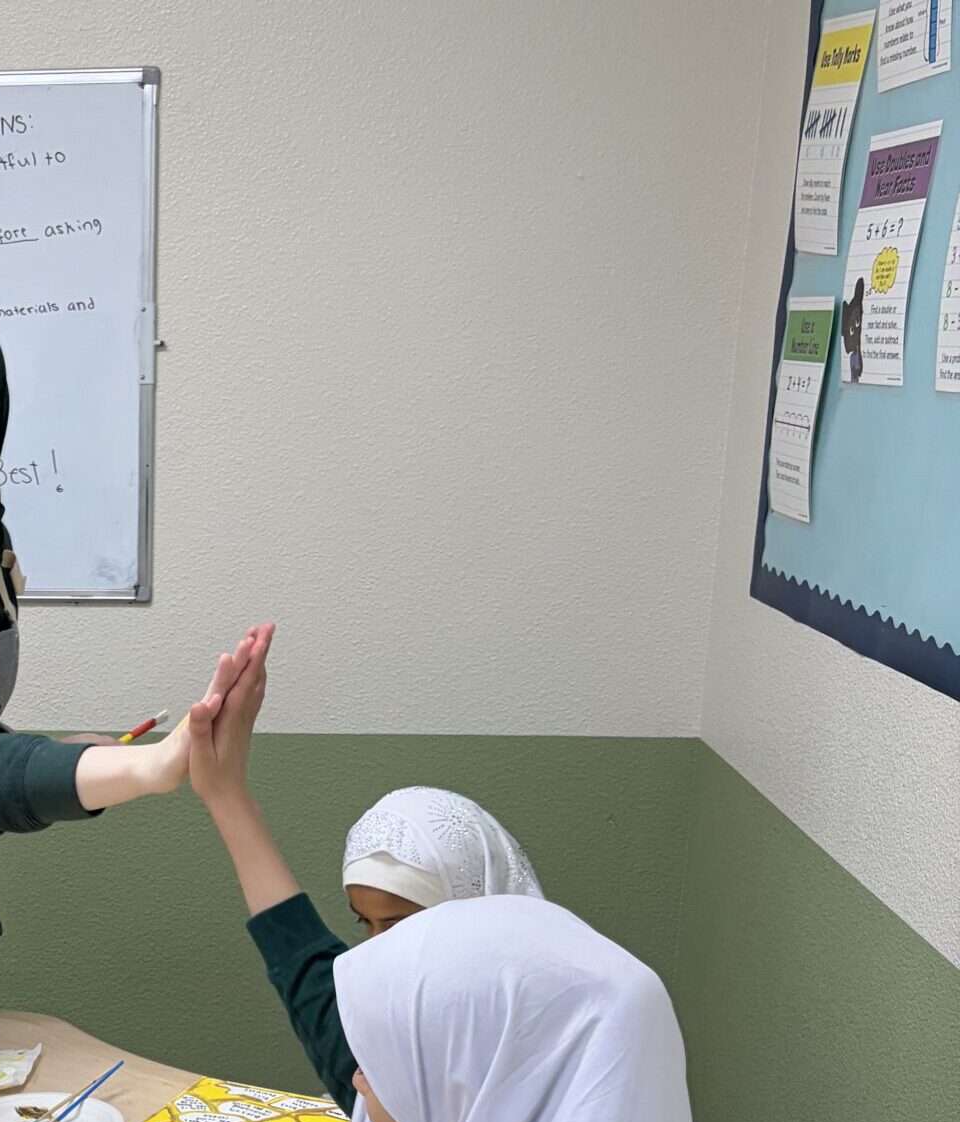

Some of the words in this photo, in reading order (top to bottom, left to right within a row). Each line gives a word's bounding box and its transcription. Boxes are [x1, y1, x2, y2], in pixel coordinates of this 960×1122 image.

[45, 150, 66, 166] to
[885, 150, 915, 174] Doubles
[892, 174, 916, 196] Facts
[44, 217, 103, 239] asking
[866, 223, 874, 240] 5
[67, 297, 96, 312] and
